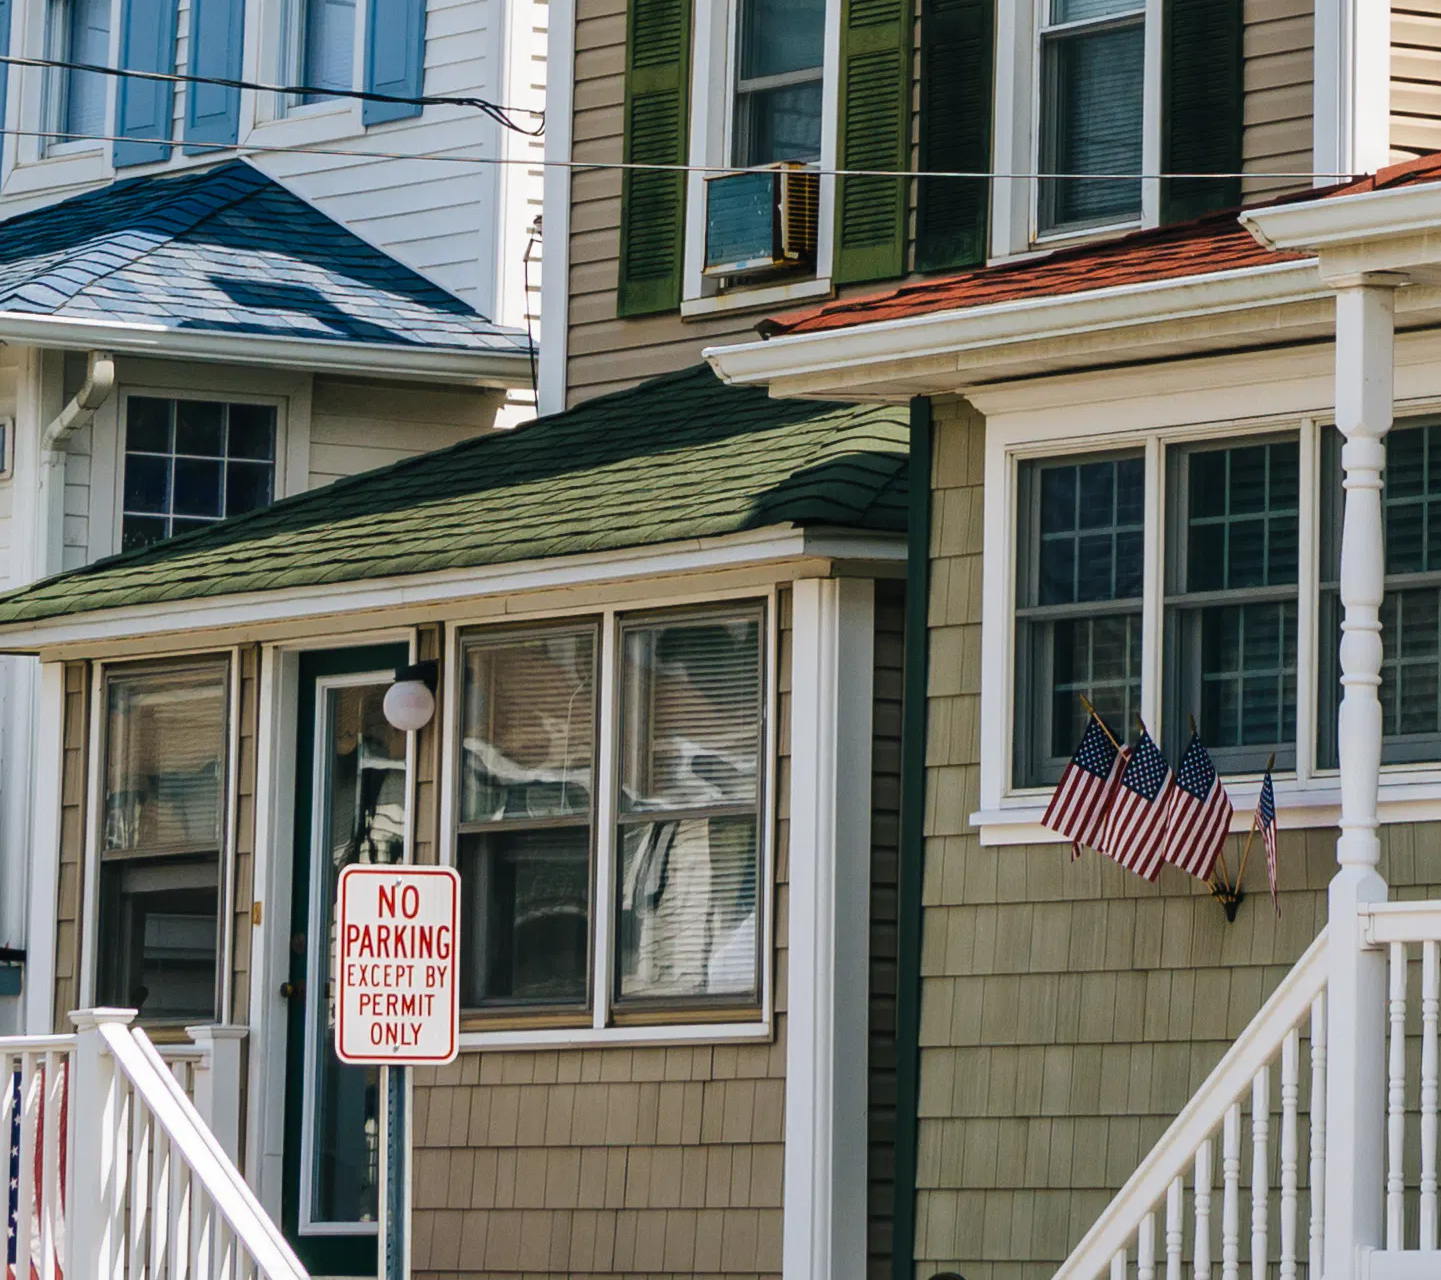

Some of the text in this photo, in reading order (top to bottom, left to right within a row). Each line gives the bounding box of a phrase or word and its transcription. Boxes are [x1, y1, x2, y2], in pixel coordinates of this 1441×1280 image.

[378, 885, 420, 919] NO
[346, 924, 450, 960] PARKING
[347, 964, 448, 988] EXCEPT BY
[359, 993, 435, 1017] PERMIT
[370, 1022, 423, 1045] ONLY
